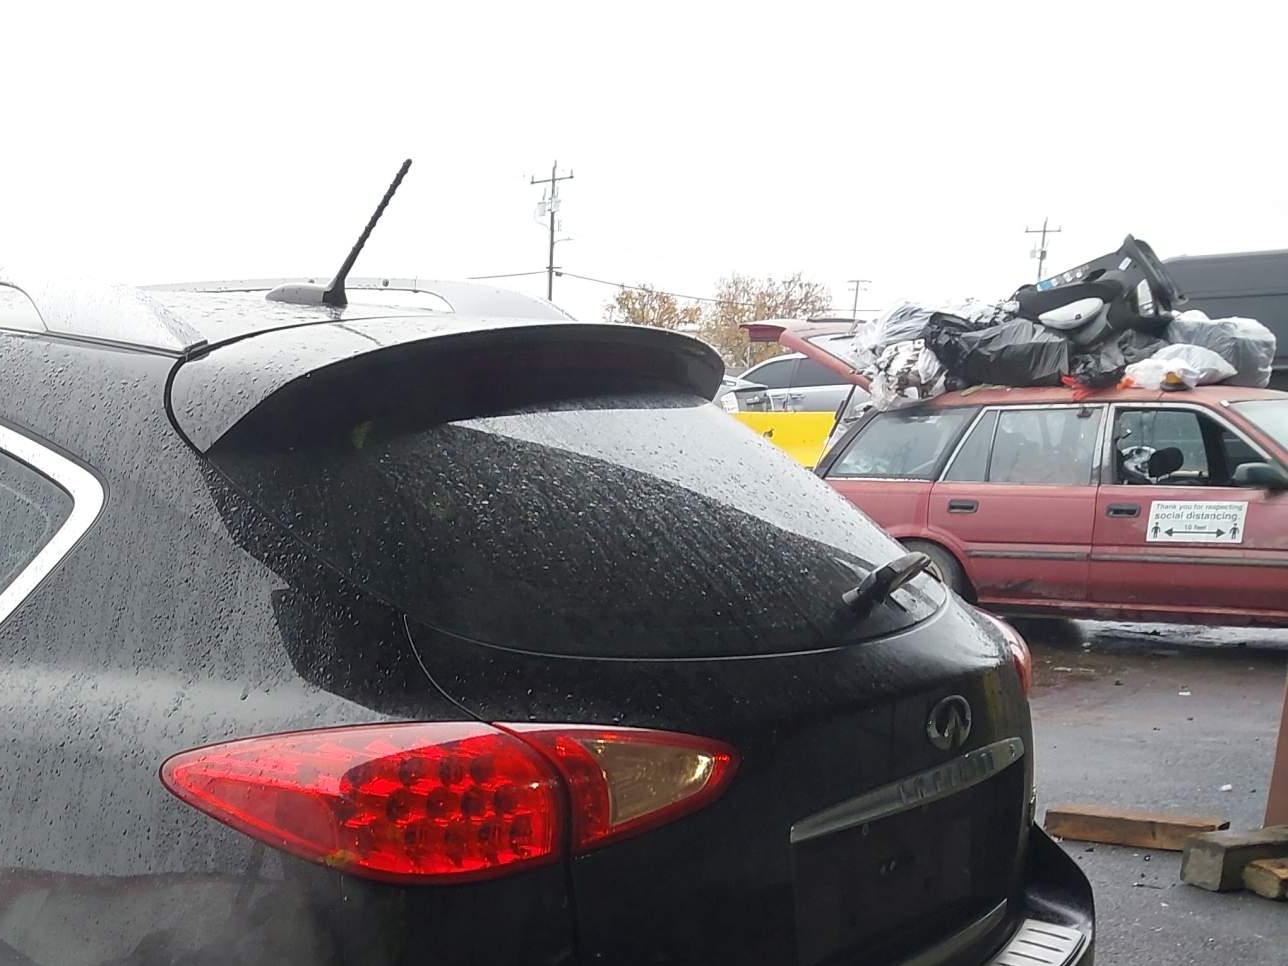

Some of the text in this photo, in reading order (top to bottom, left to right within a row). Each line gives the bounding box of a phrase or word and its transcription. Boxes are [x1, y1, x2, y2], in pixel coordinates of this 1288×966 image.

[1205, 504, 1243, 512] respecting
[1154, 511, 1241, 522] social distancing.
